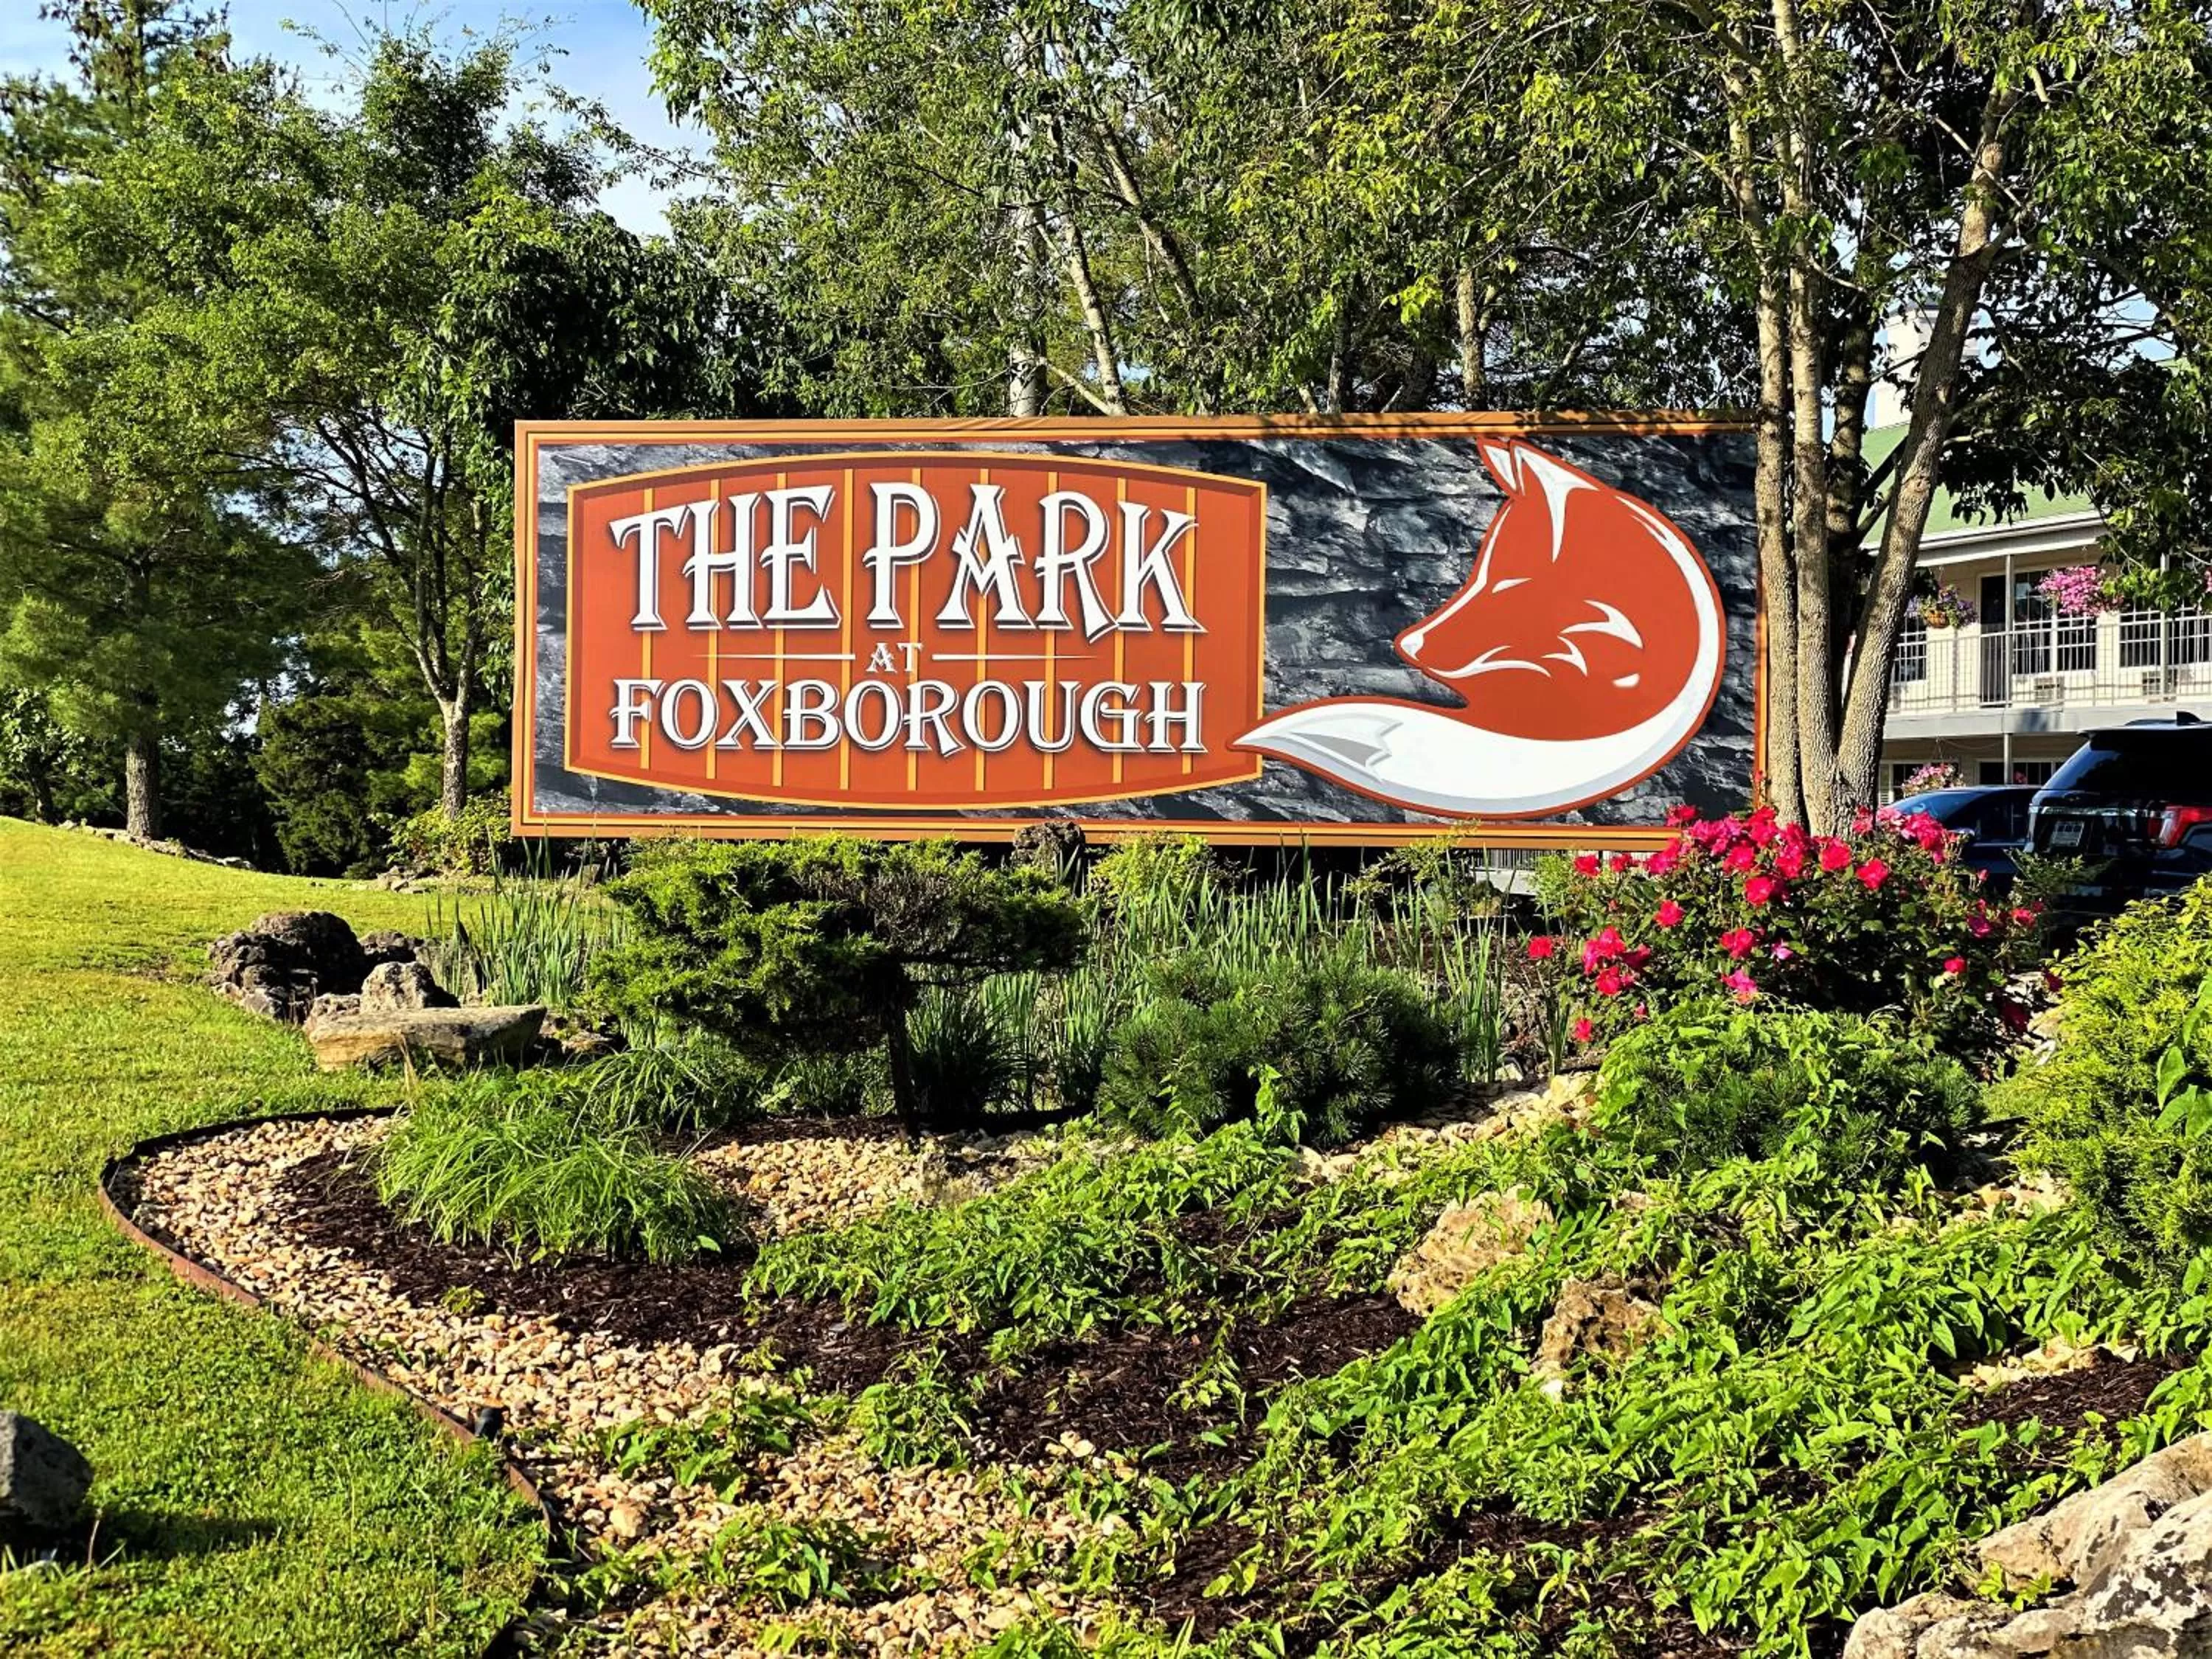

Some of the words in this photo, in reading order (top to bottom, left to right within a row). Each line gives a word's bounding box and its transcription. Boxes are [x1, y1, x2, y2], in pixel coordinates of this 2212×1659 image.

[609, 484, 841, 631] THE
[863, 481, 1207, 644] PARK
[866, 641, 922, 673] AT
[609, 678, 1207, 756] FOXBOROUGH
